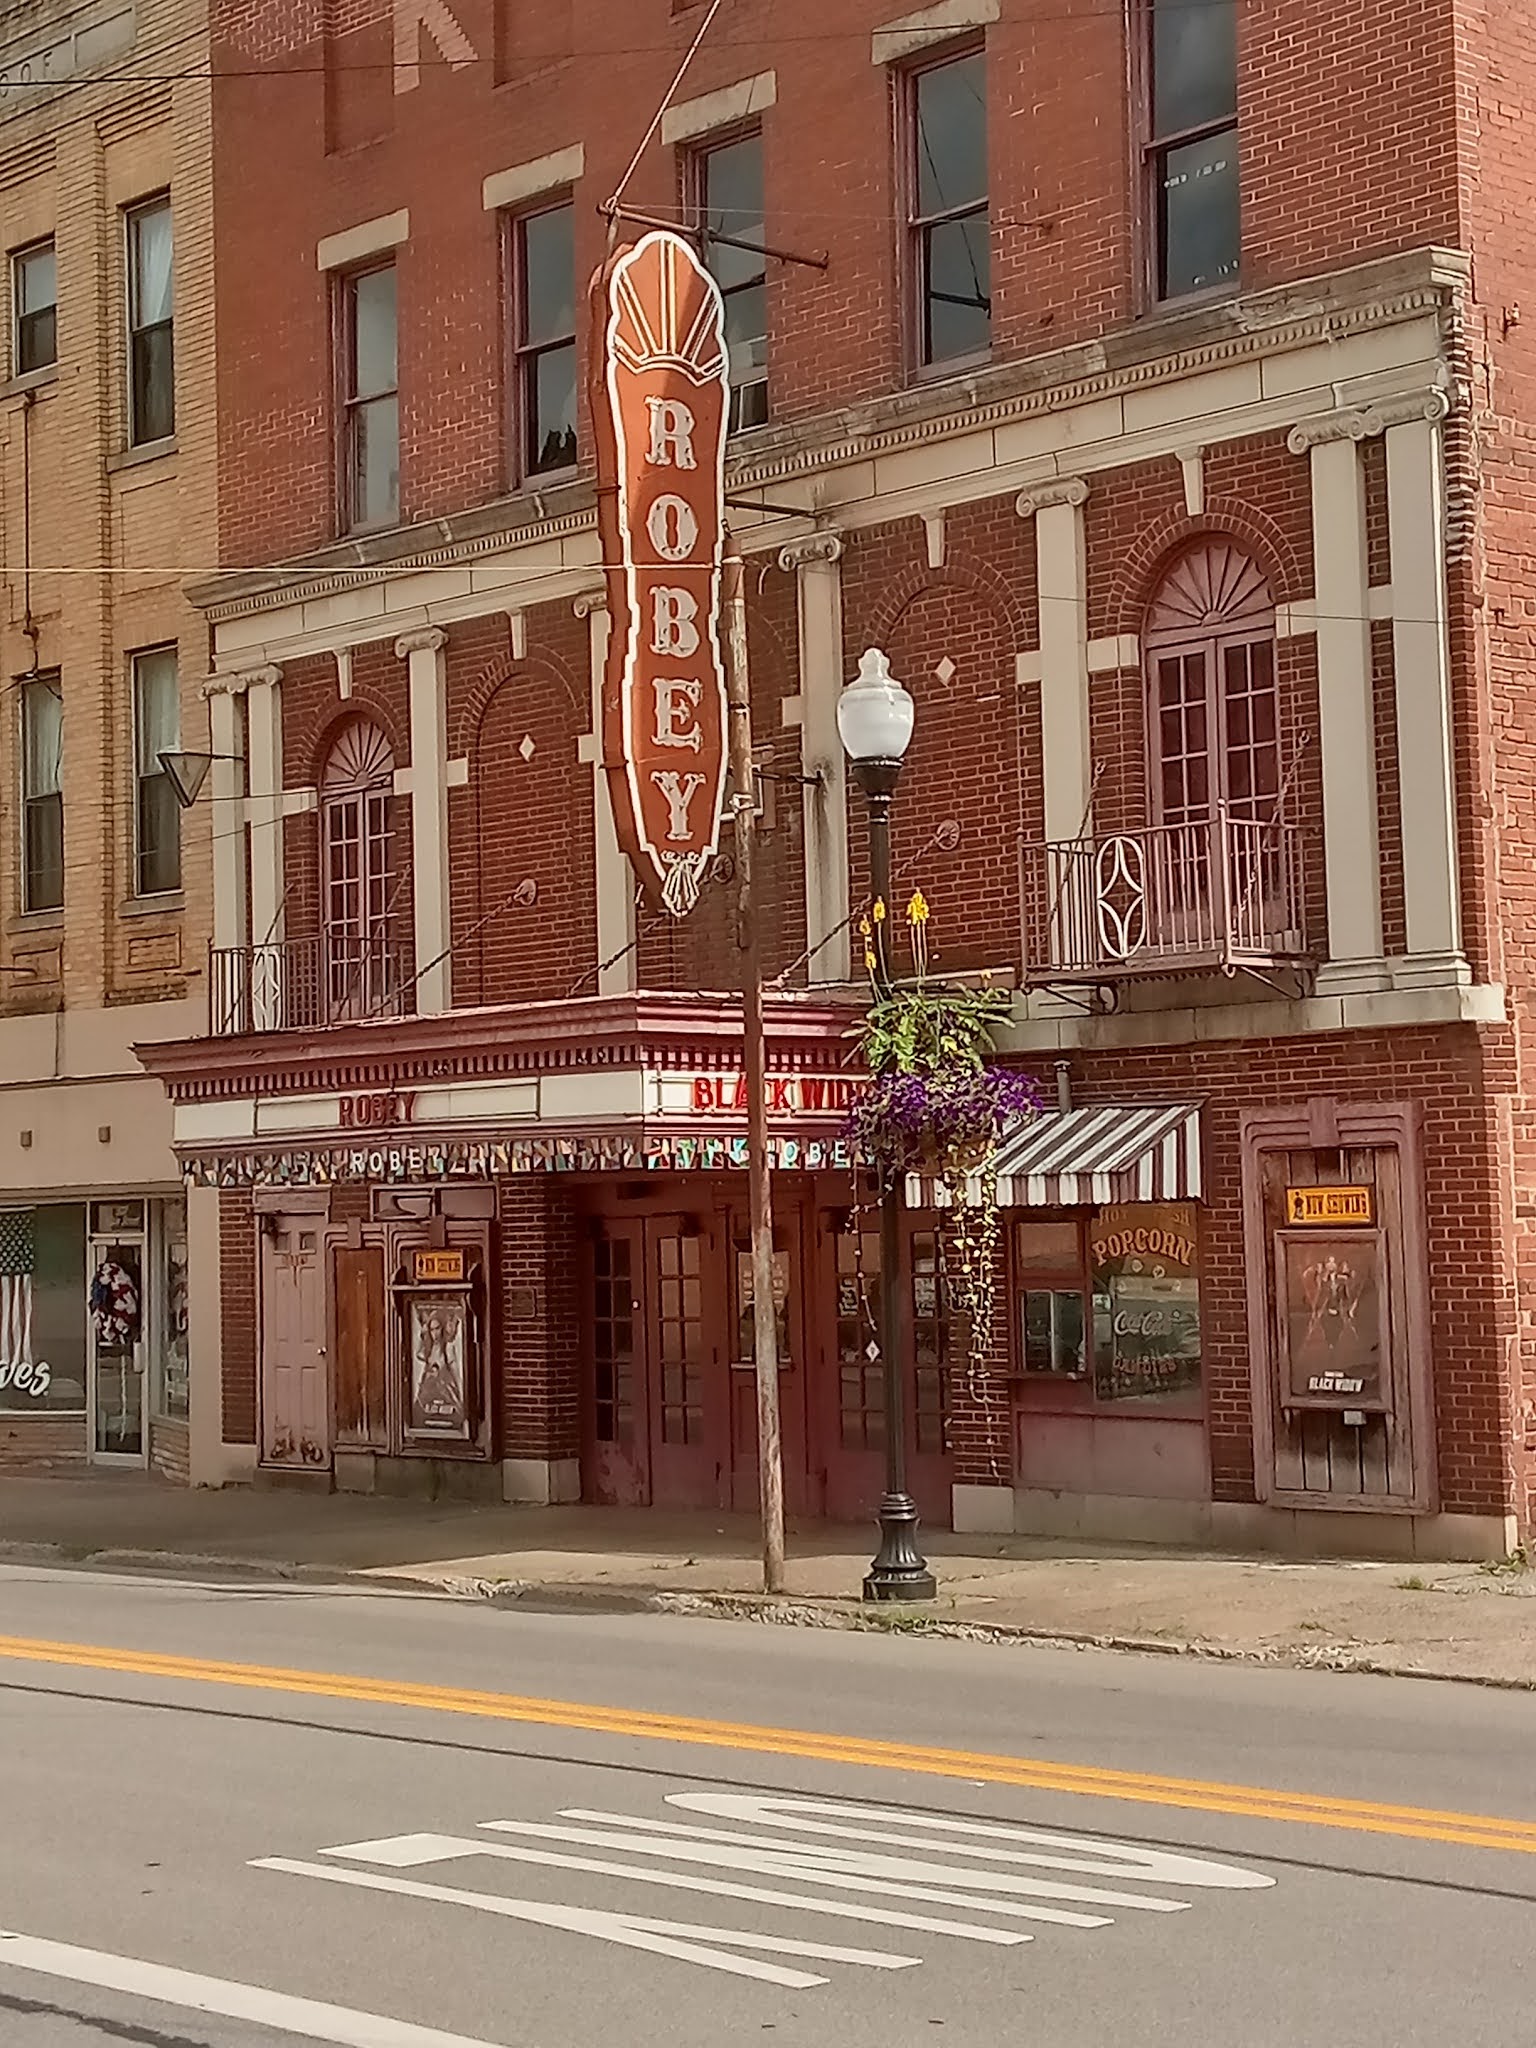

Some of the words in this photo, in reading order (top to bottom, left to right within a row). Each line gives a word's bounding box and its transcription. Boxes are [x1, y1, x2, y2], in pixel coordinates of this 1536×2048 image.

[644, 394, 706, 841] ROBEY
[339, 1091, 417, 1126] ROBEY
[1092, 1227, 1195, 1267] POPCORN
[246, 1792, 1277, 1989] ONLY
